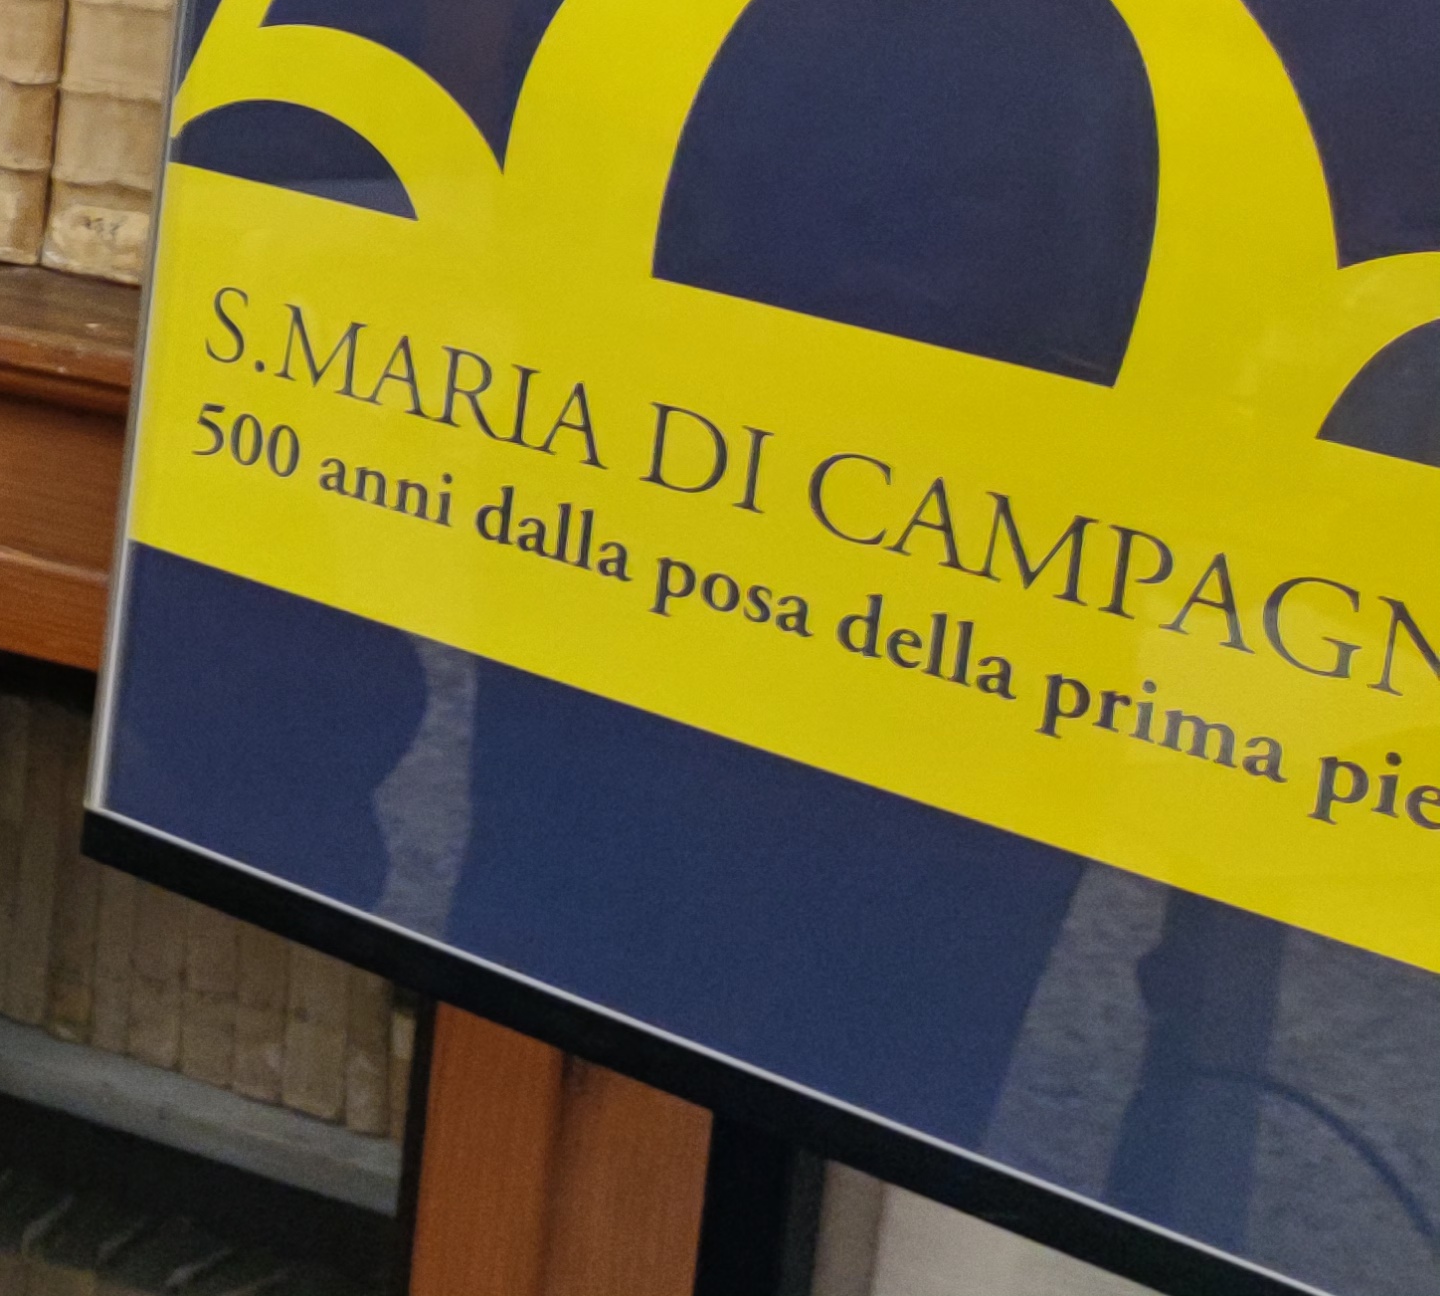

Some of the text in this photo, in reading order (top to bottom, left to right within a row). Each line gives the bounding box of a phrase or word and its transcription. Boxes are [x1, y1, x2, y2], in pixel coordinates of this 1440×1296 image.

[640, 402, 774, 515] DI
[192, 402, 301, 479] 500
[319, 470, 455, 527] anni
[475, 485, 632, 582] dalla
[651, 556, 813, 639] posa
[837, 593, 1018, 700] della
[1034, 673, 1287, 784] prima
